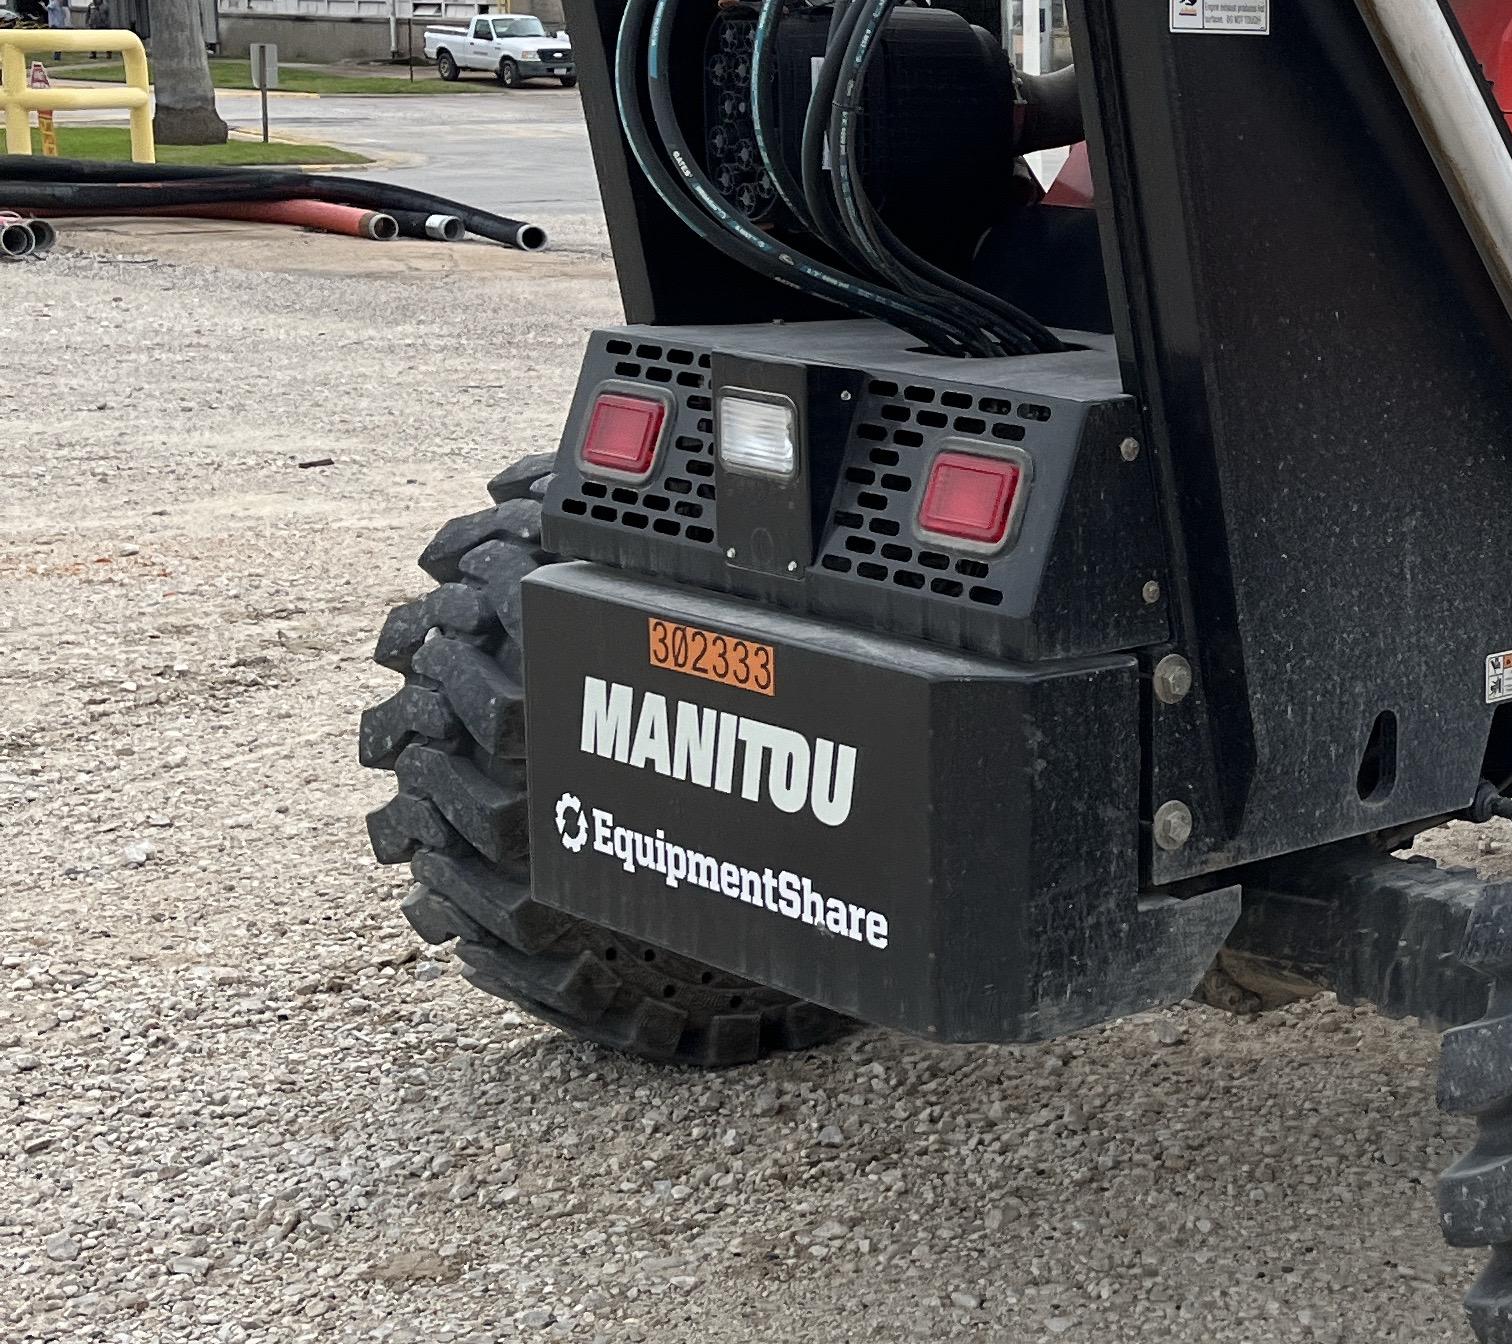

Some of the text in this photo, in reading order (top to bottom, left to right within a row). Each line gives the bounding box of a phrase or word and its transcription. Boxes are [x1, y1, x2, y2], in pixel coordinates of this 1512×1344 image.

[652, 621, 772, 690] 302333
[580, 676, 858, 827] MANITOU
[592, 806, 890, 950] EquipmentShare
